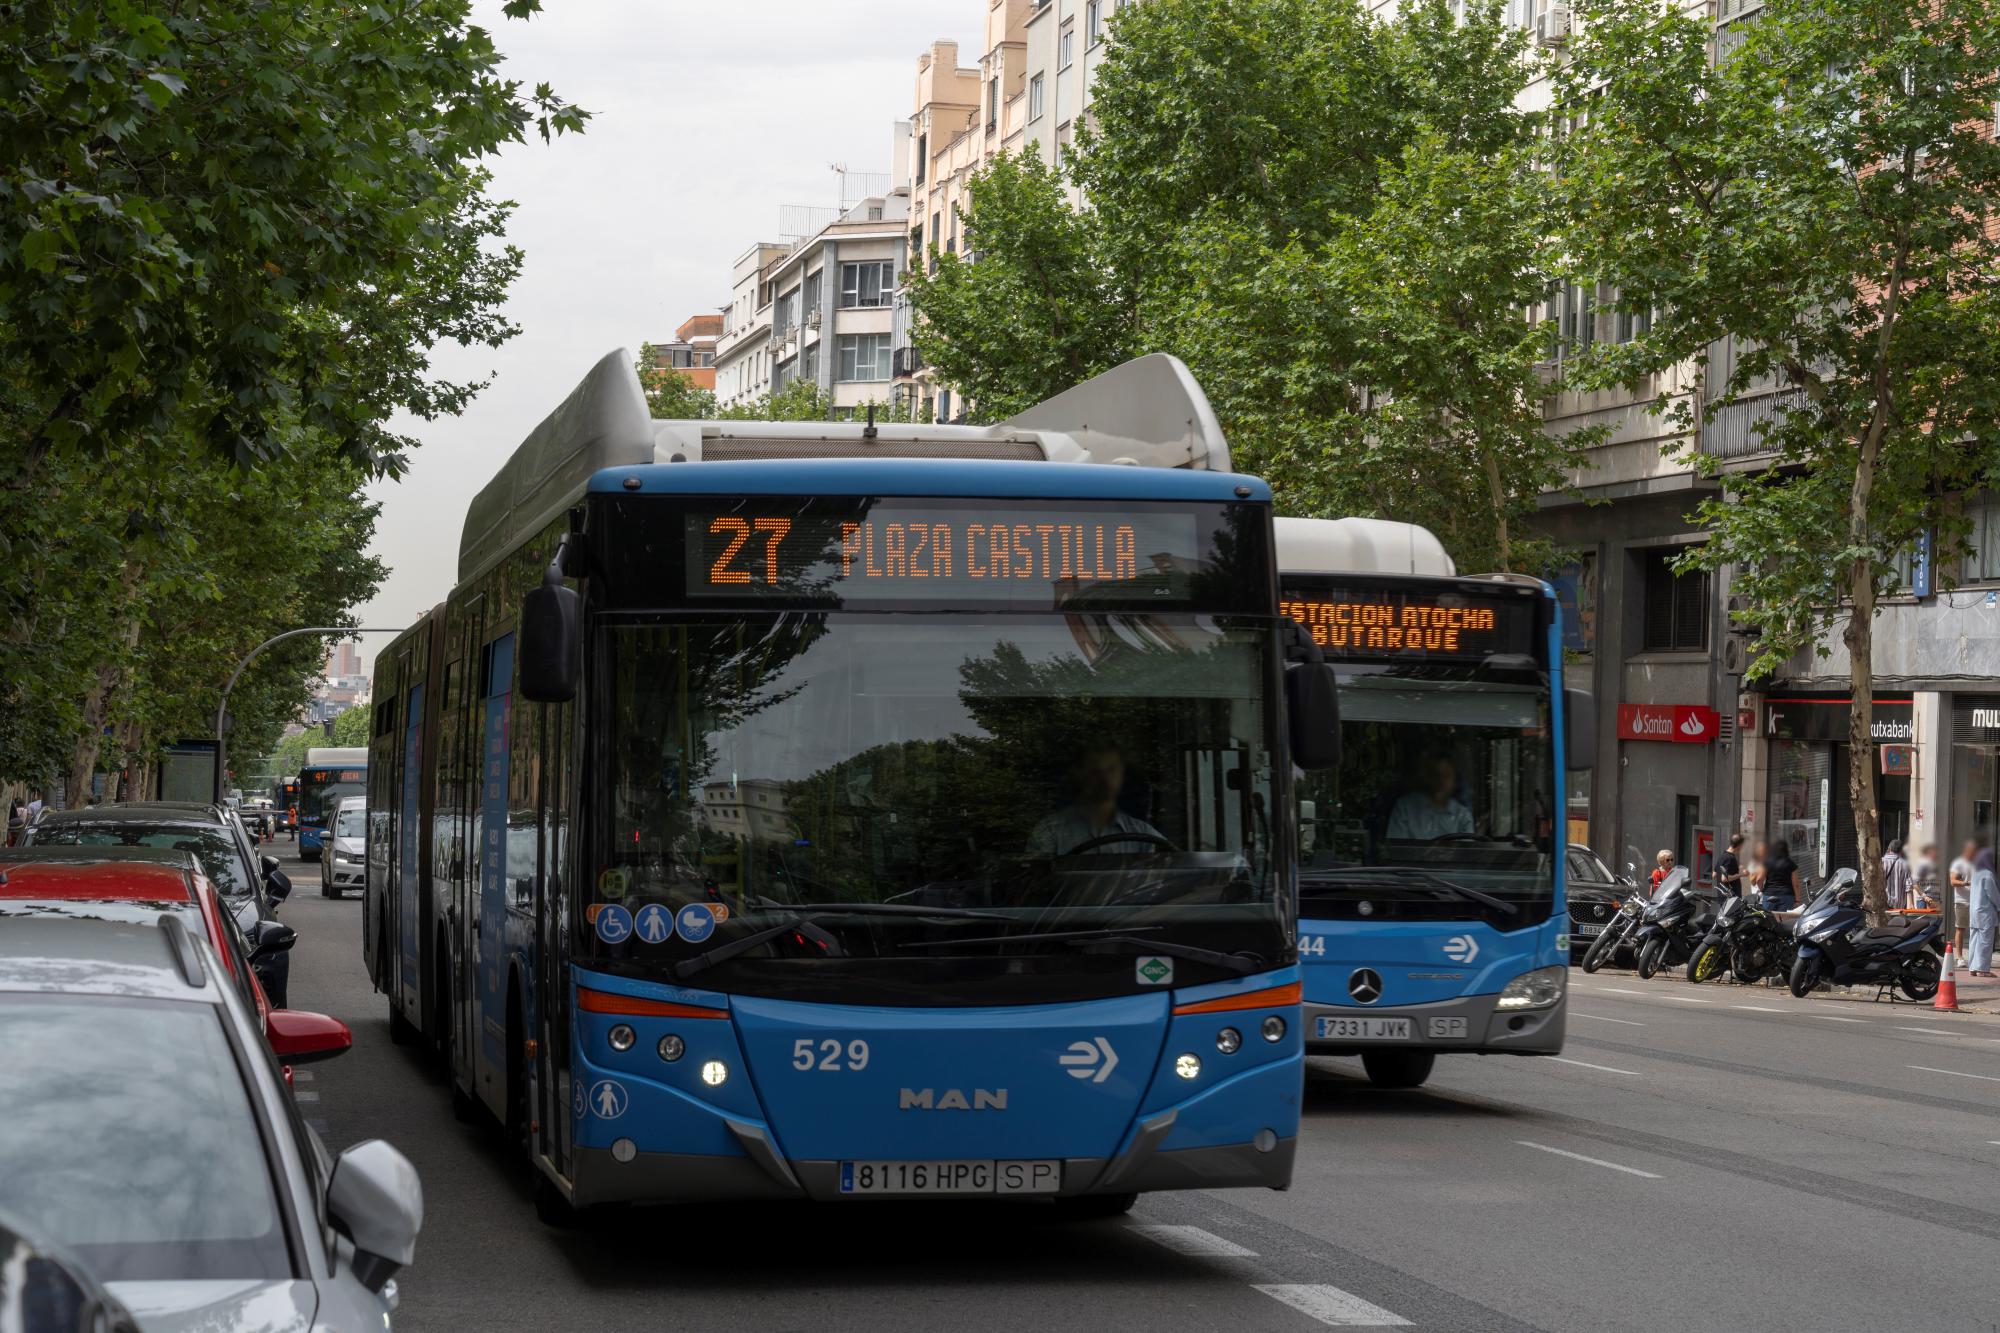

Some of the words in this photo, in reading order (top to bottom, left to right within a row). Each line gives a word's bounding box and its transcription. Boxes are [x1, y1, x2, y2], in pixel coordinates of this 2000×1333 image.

[709, 517, 791, 585] 27
[842, 522, 952, 578] PLAZA
[967, 523, 1136, 580] CASTILLA
[1401, 606, 1494, 630] ATOCHA
[1312, 625, 1459, 650] BUTARQUE
[1643, 713, 1673, 735] Santan
[715, 905, 724, 917] 2
[1144, 966, 1165, 975] GNC
[1326, 1019, 1369, 1037] 7331
[1376, 1021, 1407, 1037] JVK
[1434, 1018, 1463, 1036] SP
[792, 1039, 870, 1072] 529
[898, 1088, 1007, 1110] MAN
[859, 1164, 928, 1190] 8116
[937, 1164, 988, 1190] HPG
[1004, 1164, 1052, 1189] SP
